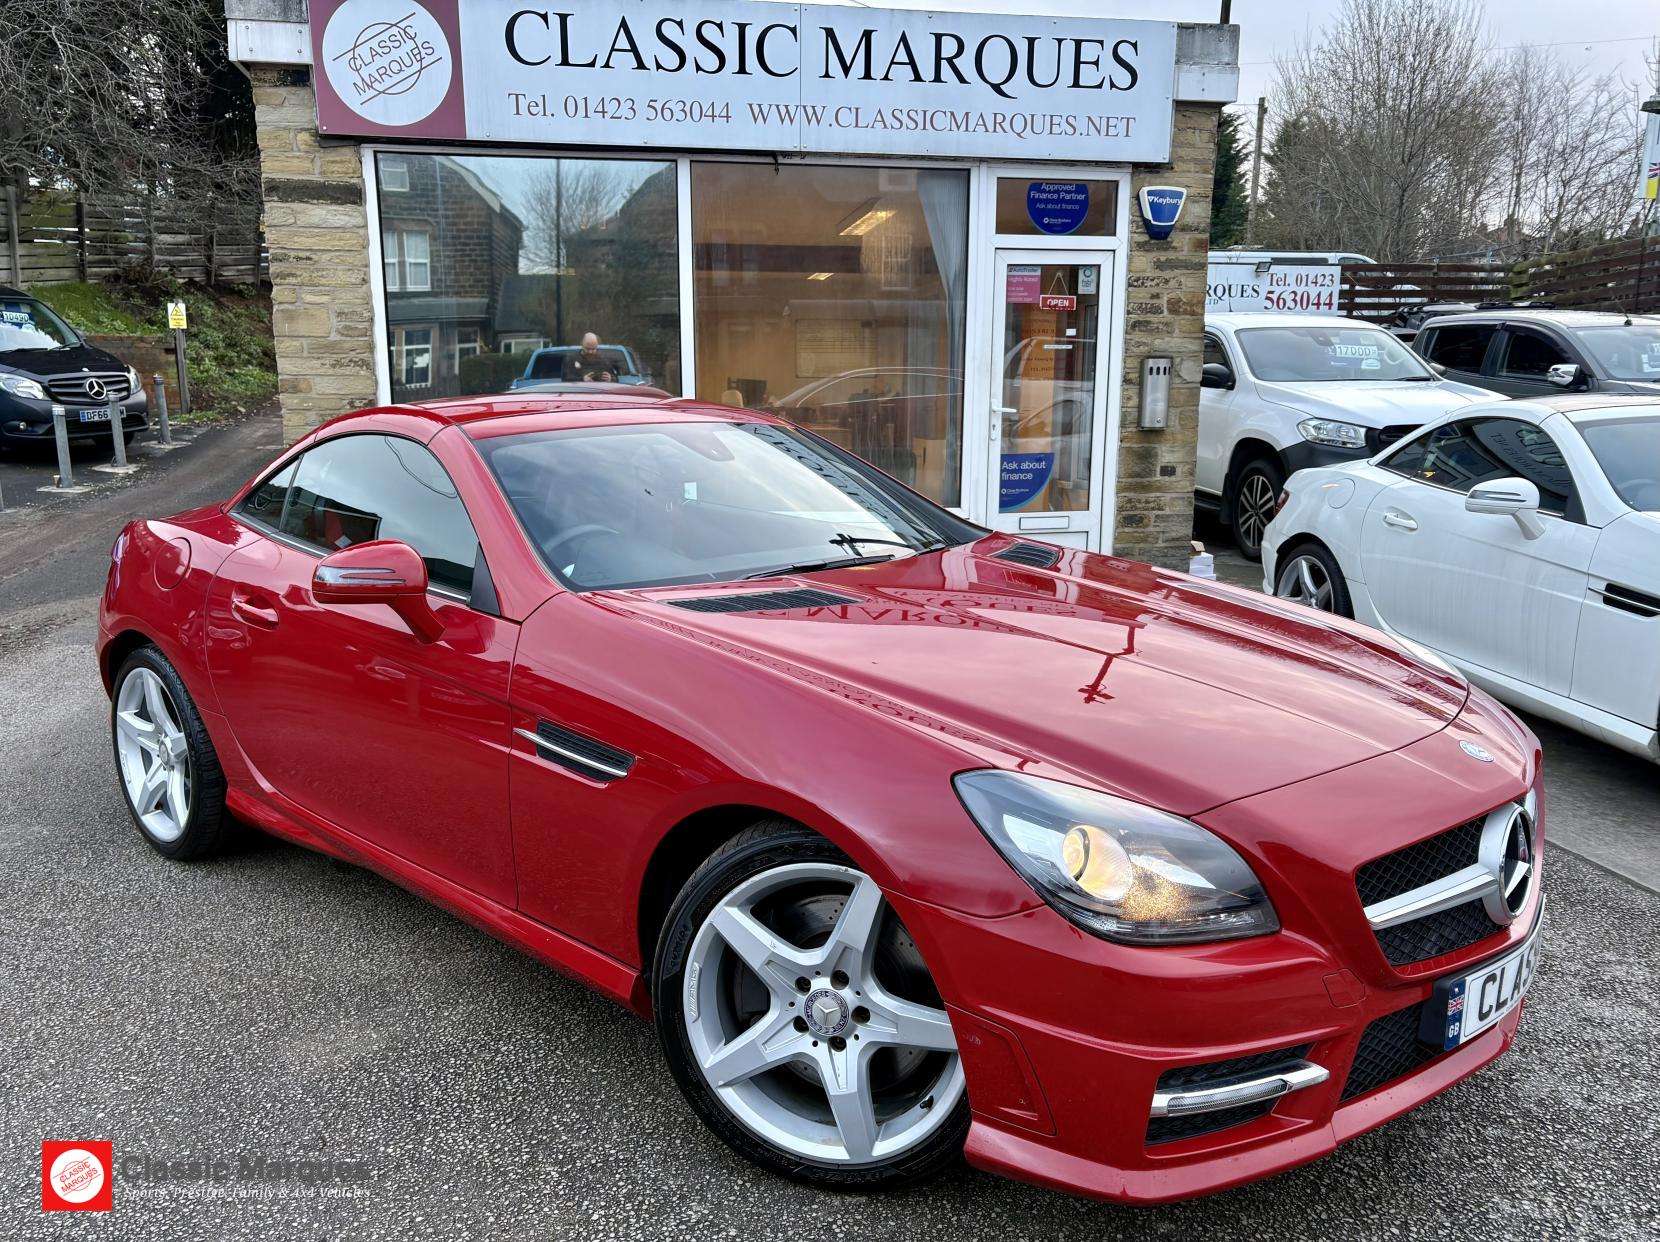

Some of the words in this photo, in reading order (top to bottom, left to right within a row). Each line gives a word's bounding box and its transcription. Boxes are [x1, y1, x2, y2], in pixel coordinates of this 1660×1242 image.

[348, 25, 417, 72] CLASSIC
[504, 8, 797, 78] CLASSIC
[819, 26, 1139, 100] MARQUES
[352, 41, 435, 96] MARQUES
[508, 93, 555, 118] Tel.
[563, 95, 637, 121] 01423
[645, 99, 732, 124] 563044
[747, 102, 1137, 140] WWW.CLASSICMARQUES.NET
[1041, 183, 1076, 192] Approved
[1030, 191, 1058, 200] Finance
[1060, 192, 1086, 200] Partner
[1154, 196, 1181, 206] Keybury
[1267, 273, 1291, 287] Tel.
[1295, 273, 1335, 287] 01423
[1047, 299, 1069, 307] OPEN
[1264, 290, 1334, 311] 563044
[1002, 461, 1018, 469] Ask
[1020, 461, 1047, 469] about
[1002, 472, 1033, 481] finance
[1448, 1022, 1460, 1039] GB
